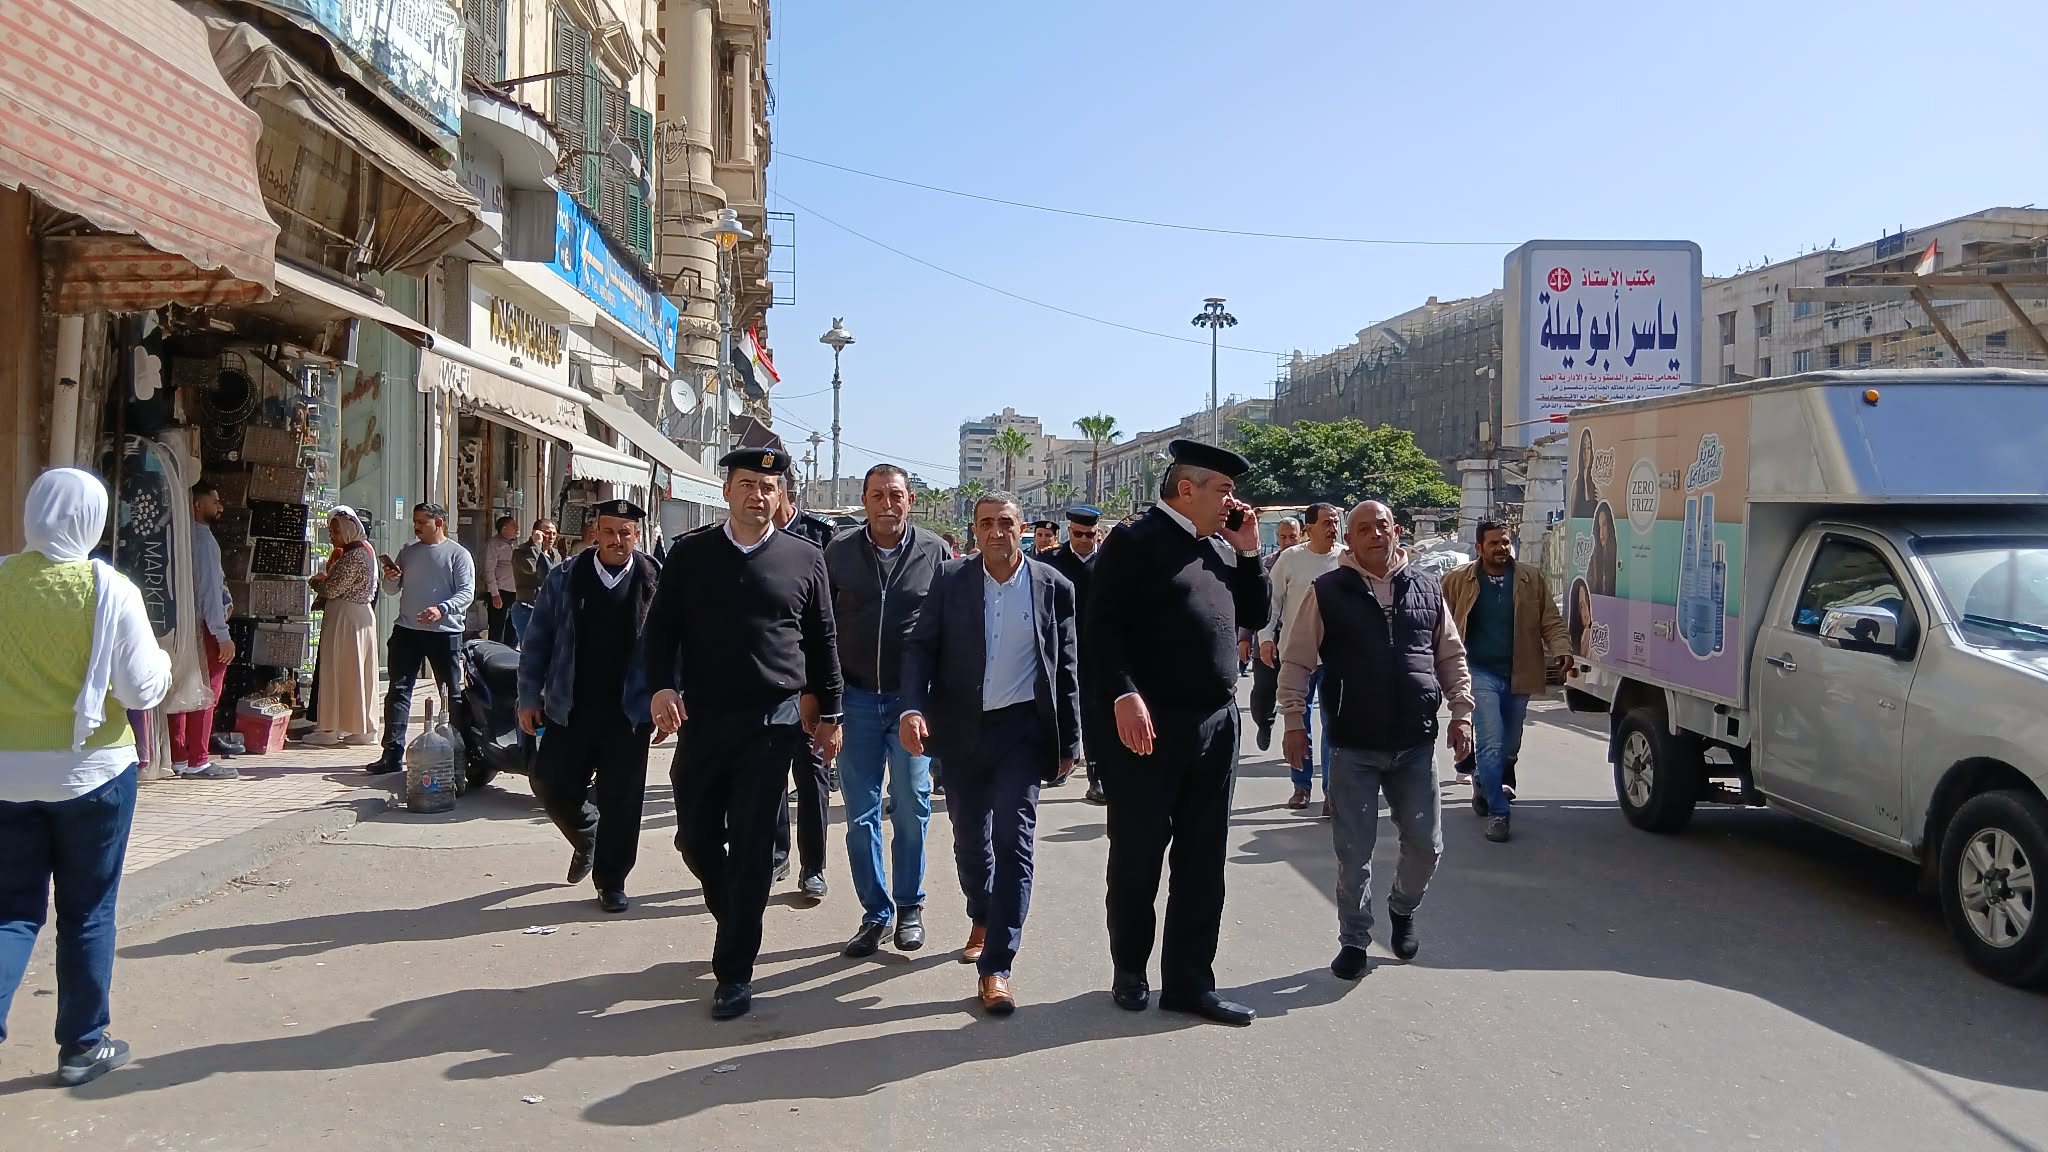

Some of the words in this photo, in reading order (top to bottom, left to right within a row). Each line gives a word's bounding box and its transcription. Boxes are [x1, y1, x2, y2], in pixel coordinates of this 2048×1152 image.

[1581, 267, 1623, 287] الأستاذ
[1625, 269, 1655, 291] مكتب
[1624, 298, 1680, 372] ياسر
[1632, 480, 1655, 495] ZERO
[1631, 498, 1654, 512] FRIZZ
[144, 541, 166, 629] MARKET
